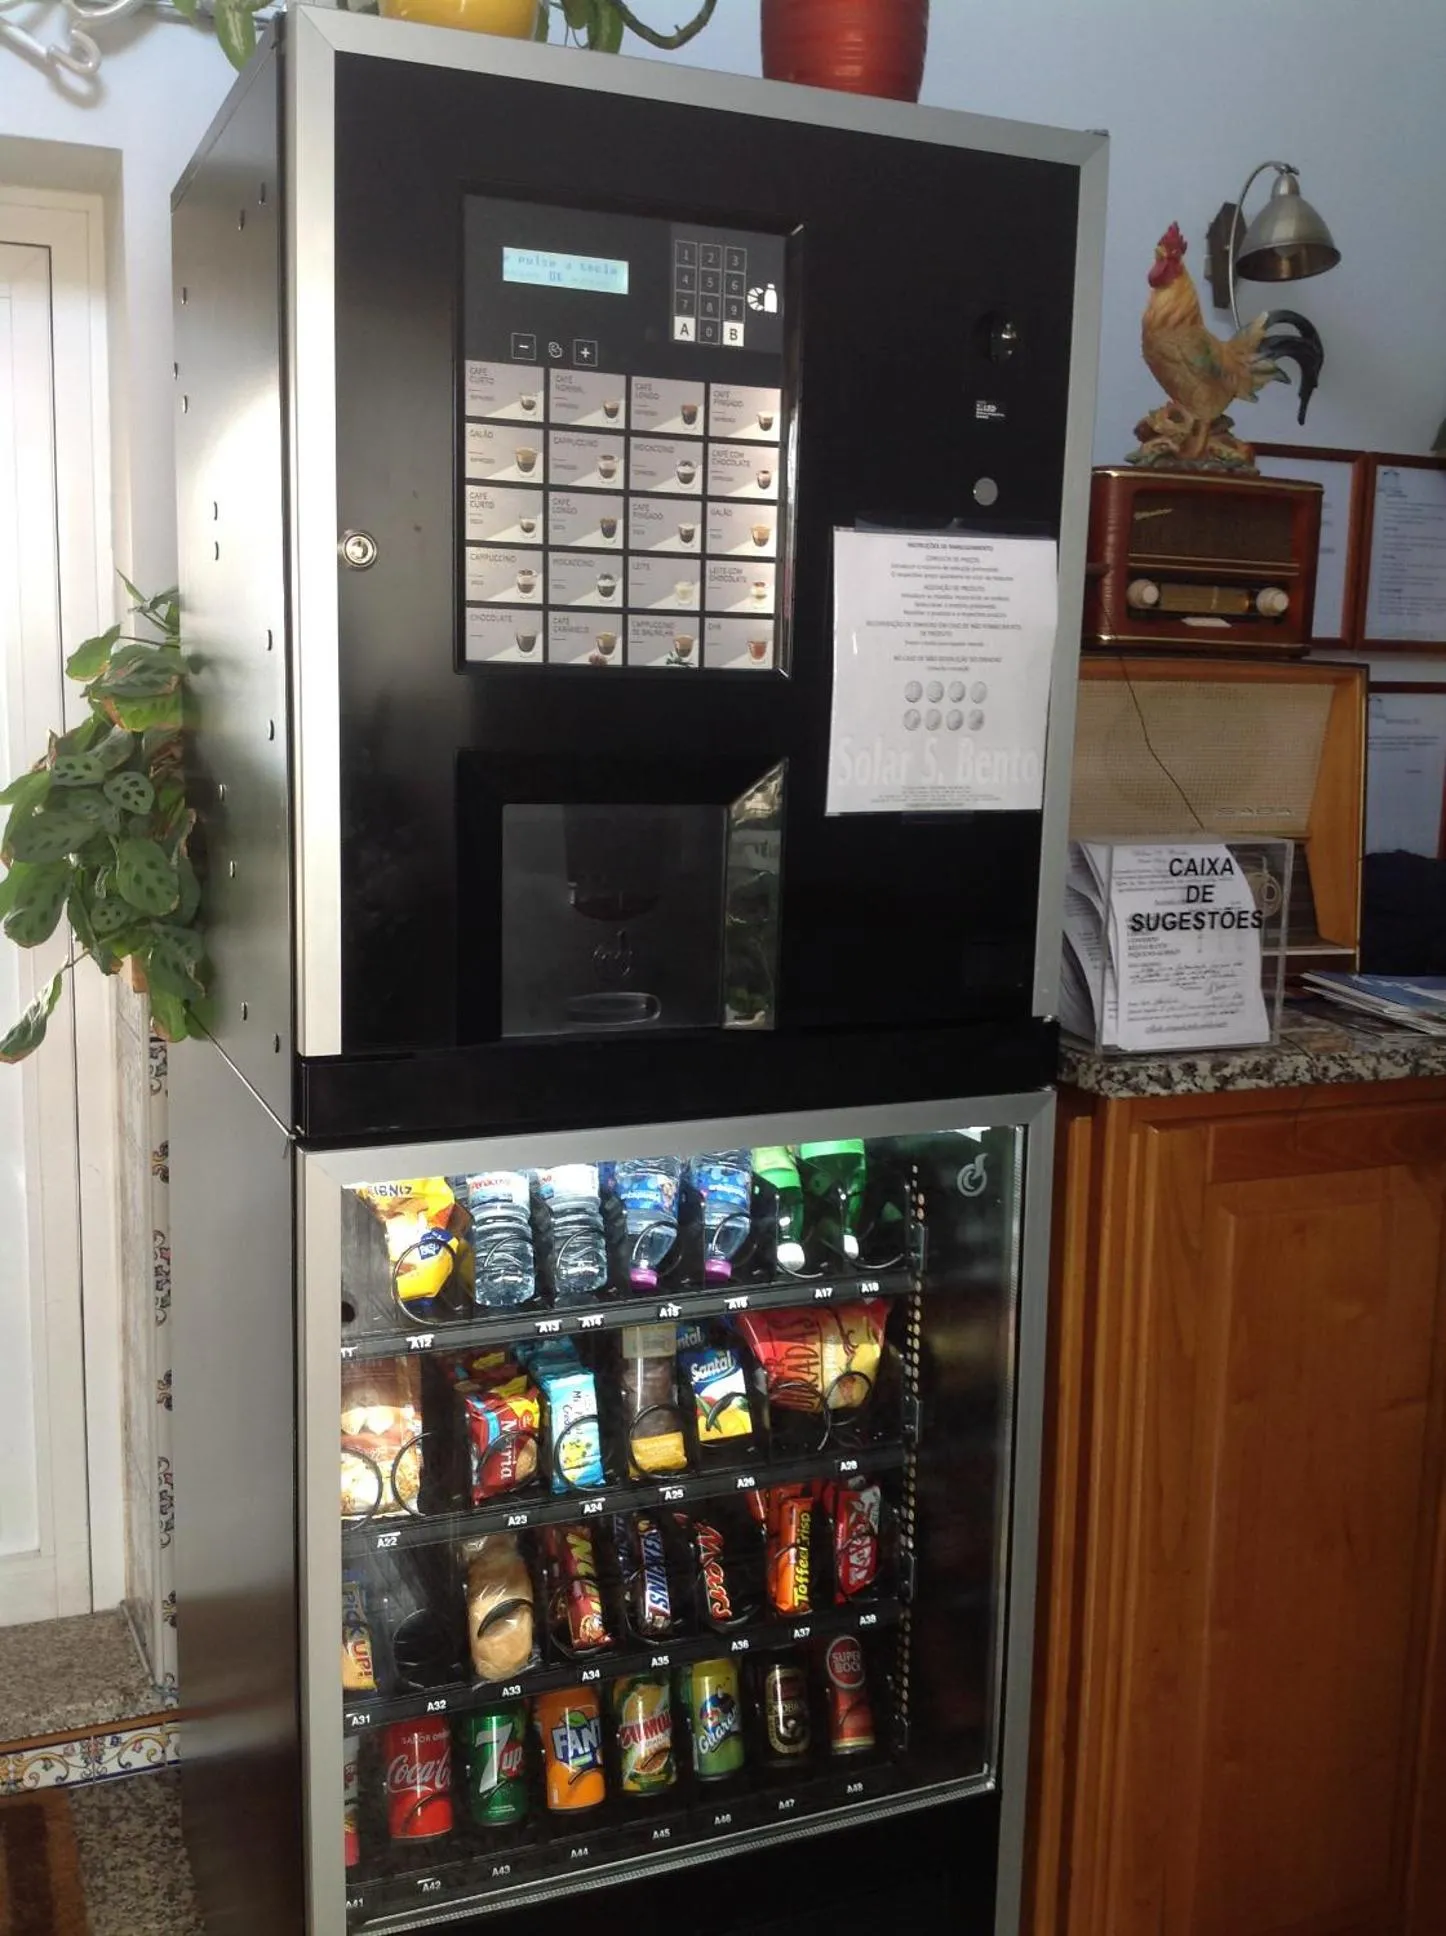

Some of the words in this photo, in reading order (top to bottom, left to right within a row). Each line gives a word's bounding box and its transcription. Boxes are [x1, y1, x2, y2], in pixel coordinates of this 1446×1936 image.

[682, 250, 690, 262] 1
[707, 252, 714, 264] 2
[732, 255, 739, 267] 3
[681, 274, 689, 286] 4
[706, 277, 713, 289] 5
[731, 279, 739, 291] 6
[679, 322, 689, 337] A
[728, 327, 739, 341] B
[711, 458, 751, 468] CHOCOLATE
[836, 734, 917, 788] Solar
[920, 734, 945, 788] S.
[958, 734, 1042, 786] Bento
[1168, 856, 1235, 877] CAIXA
[1185, 884, 1216, 904] DE
[1130, 905, 1265, 933] SUGESTÕES
[814, 1288, 833, 1300] A17
[659, 1305, 680, 1319] A15
[690, 1351, 734, 1384] Santal
[736, 1478, 755, 1489] A26
[664, 1489, 684, 1501] A25
[583, 1502, 604, 1515] A24
[507, 1515, 528, 1527] A23
[376, 1536, 398, 1549] A22
[642, 1530, 670, 1611] SNICKERS
[696, 1521, 733, 1622] Mars
[859, 1614, 877, 1627] A38
[793, 1627, 811, 1639] A37
[731, 1639, 750, 1652] A36
[353, 1639, 374, 1678] UP!
[651, 1655, 670, 1668] A35
[834, 1661, 862, 1673] BOC
[581, 1669, 601, 1682] A34
[501, 1685, 522, 1698] A33
[426, 1700, 448, 1713] A32
[351, 1715, 371, 1727] A31
[778, 1799, 795, 1811] A47
[652, 1828, 671, 1840] A45
[570, 1848, 589, 1860] A44
[491, 1865, 511, 1877] A43
[422, 1880, 442, 1892] A42
